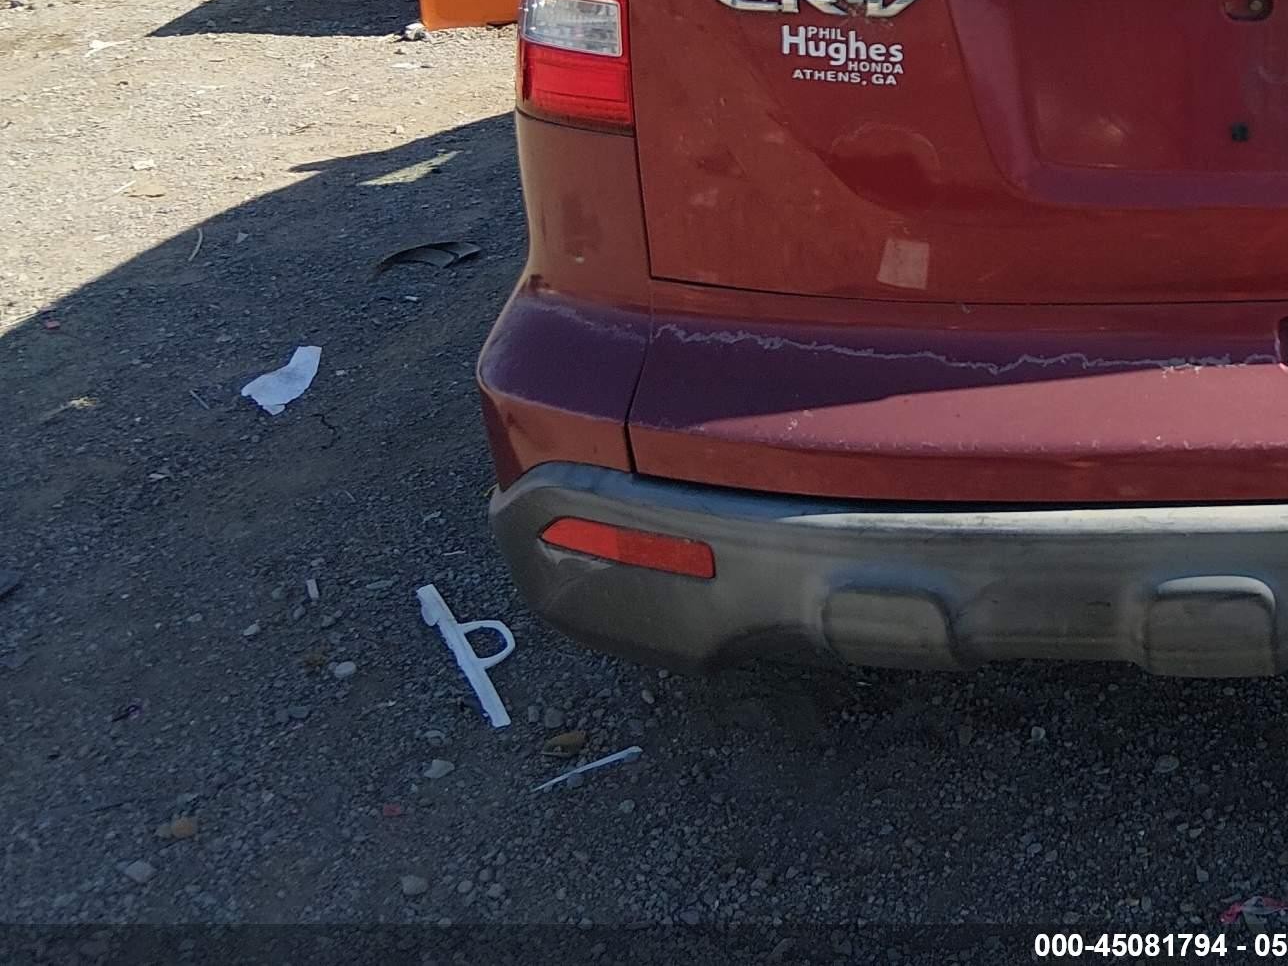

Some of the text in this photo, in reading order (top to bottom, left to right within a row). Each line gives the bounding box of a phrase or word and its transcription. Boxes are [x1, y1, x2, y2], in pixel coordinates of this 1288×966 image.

[806, 26, 846, 40] PHIL
[782, 24, 904, 65] Hughes
[847, 60, 904, 74] HONDA
[871, 74, 897, 85] GA
